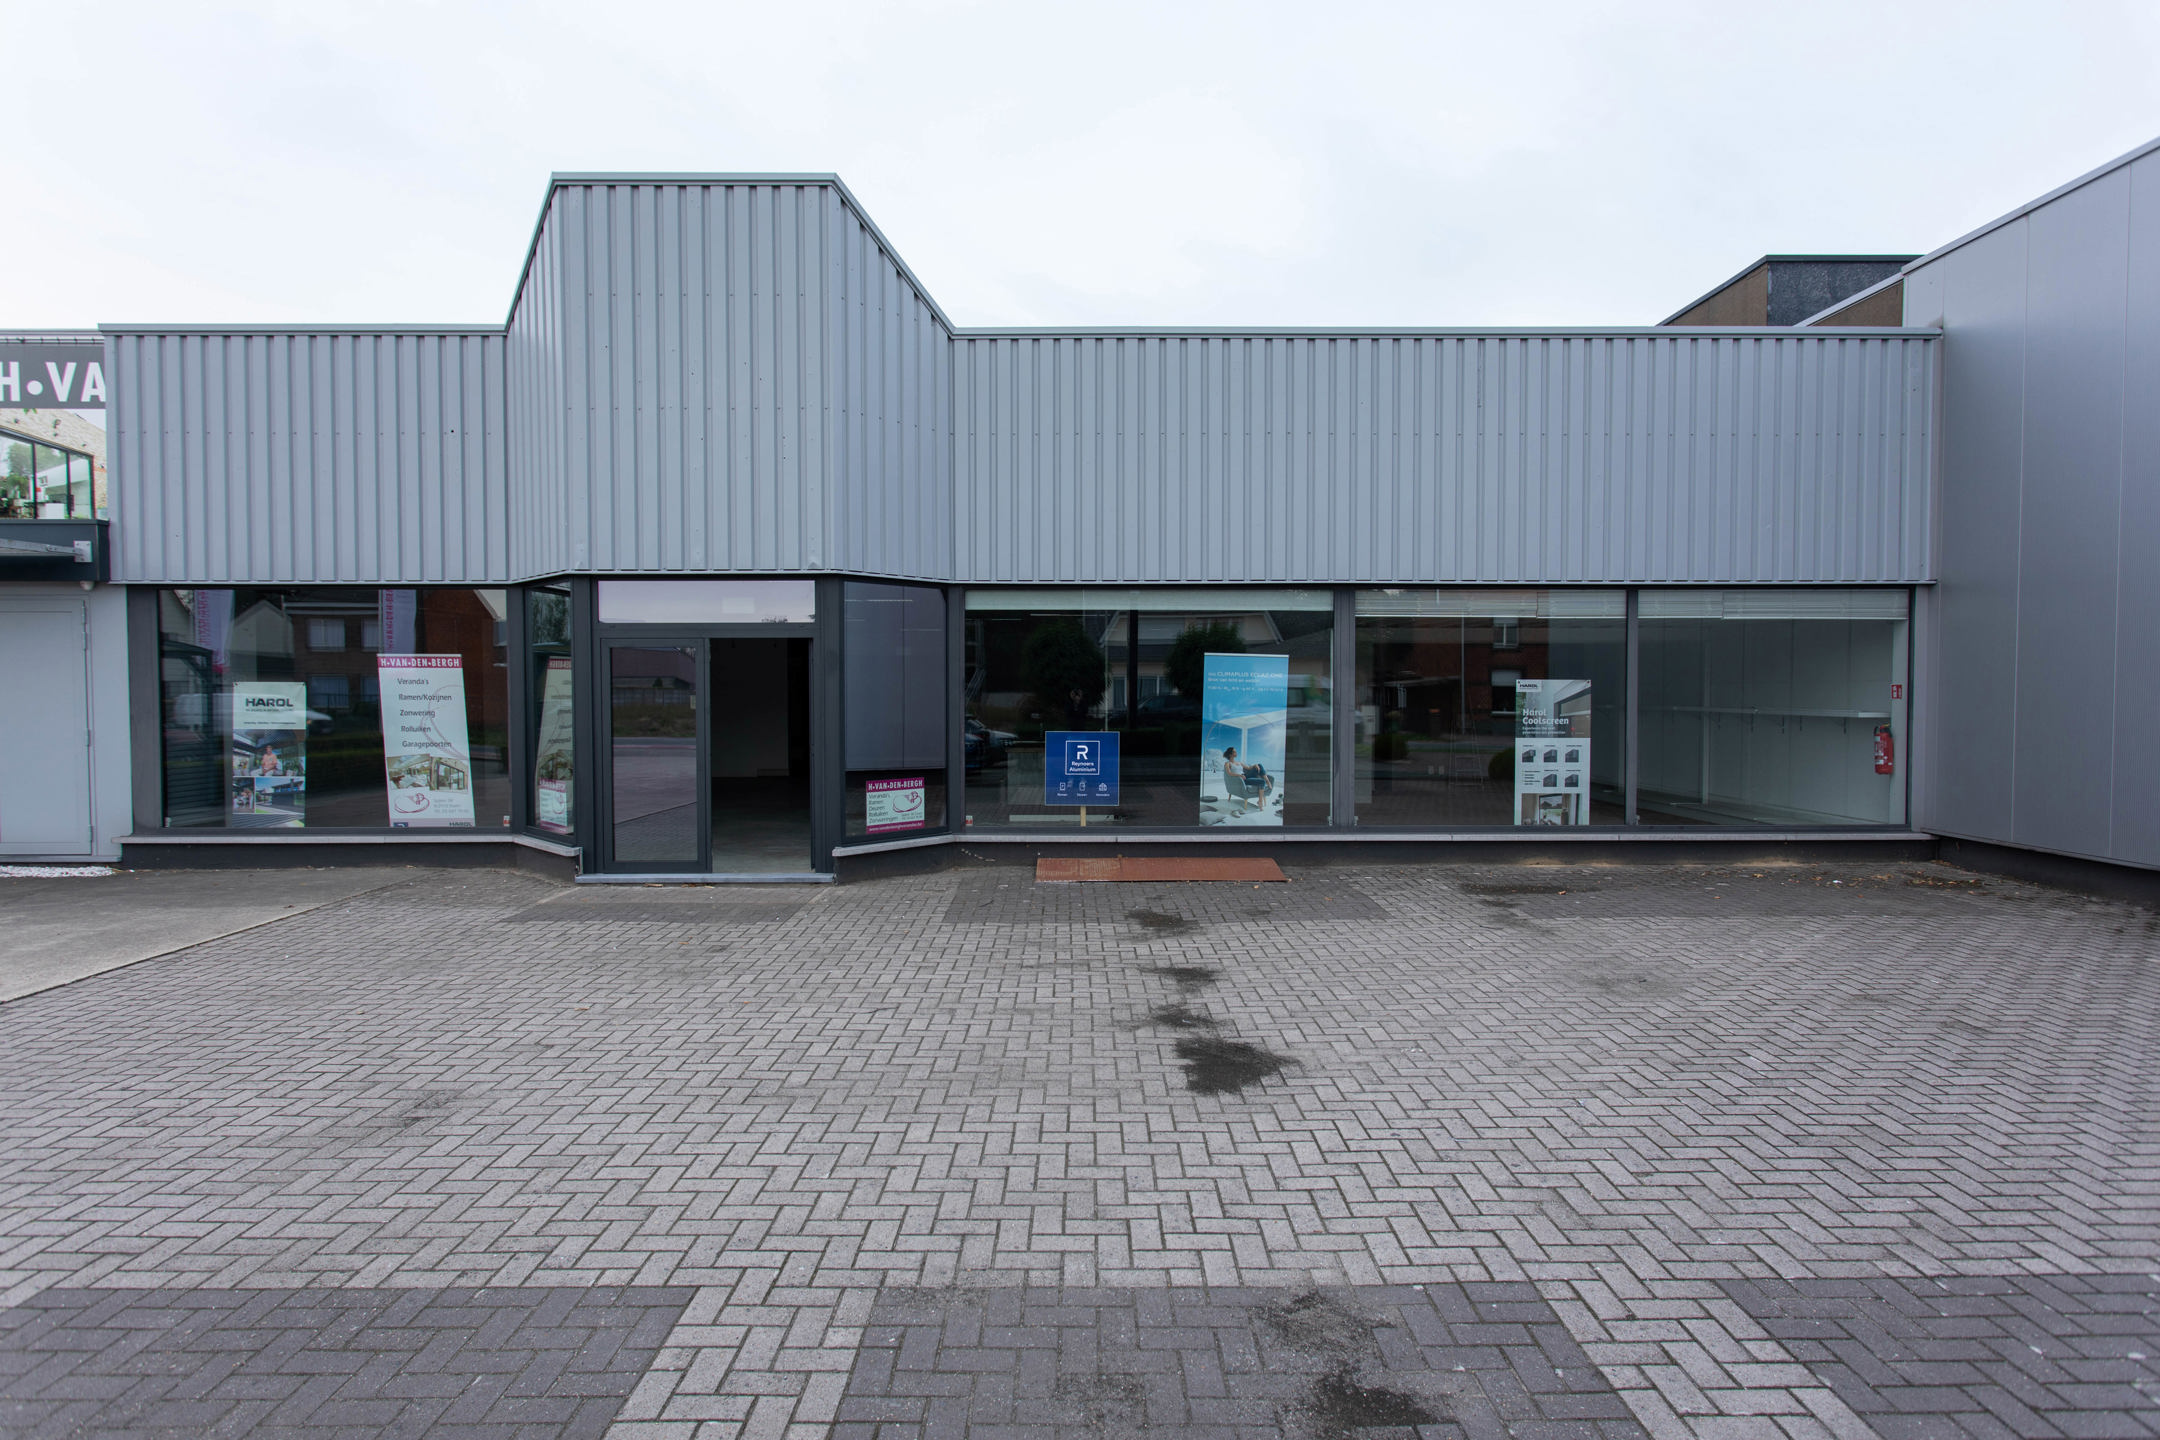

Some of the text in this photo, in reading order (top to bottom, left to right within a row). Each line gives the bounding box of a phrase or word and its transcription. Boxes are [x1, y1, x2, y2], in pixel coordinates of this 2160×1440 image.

[398, 694, 452, 702] Ramen/Kozijnen
[245, 698, 294, 707] HAROL
[400, 709, 436, 718] Zonwering
[1523, 708, 1546, 716] Harol
[1523, 717, 1569, 725] Coolscreen
[402, 740, 452, 748] Garagepoorten
[1077, 745, 1088, 760] R
